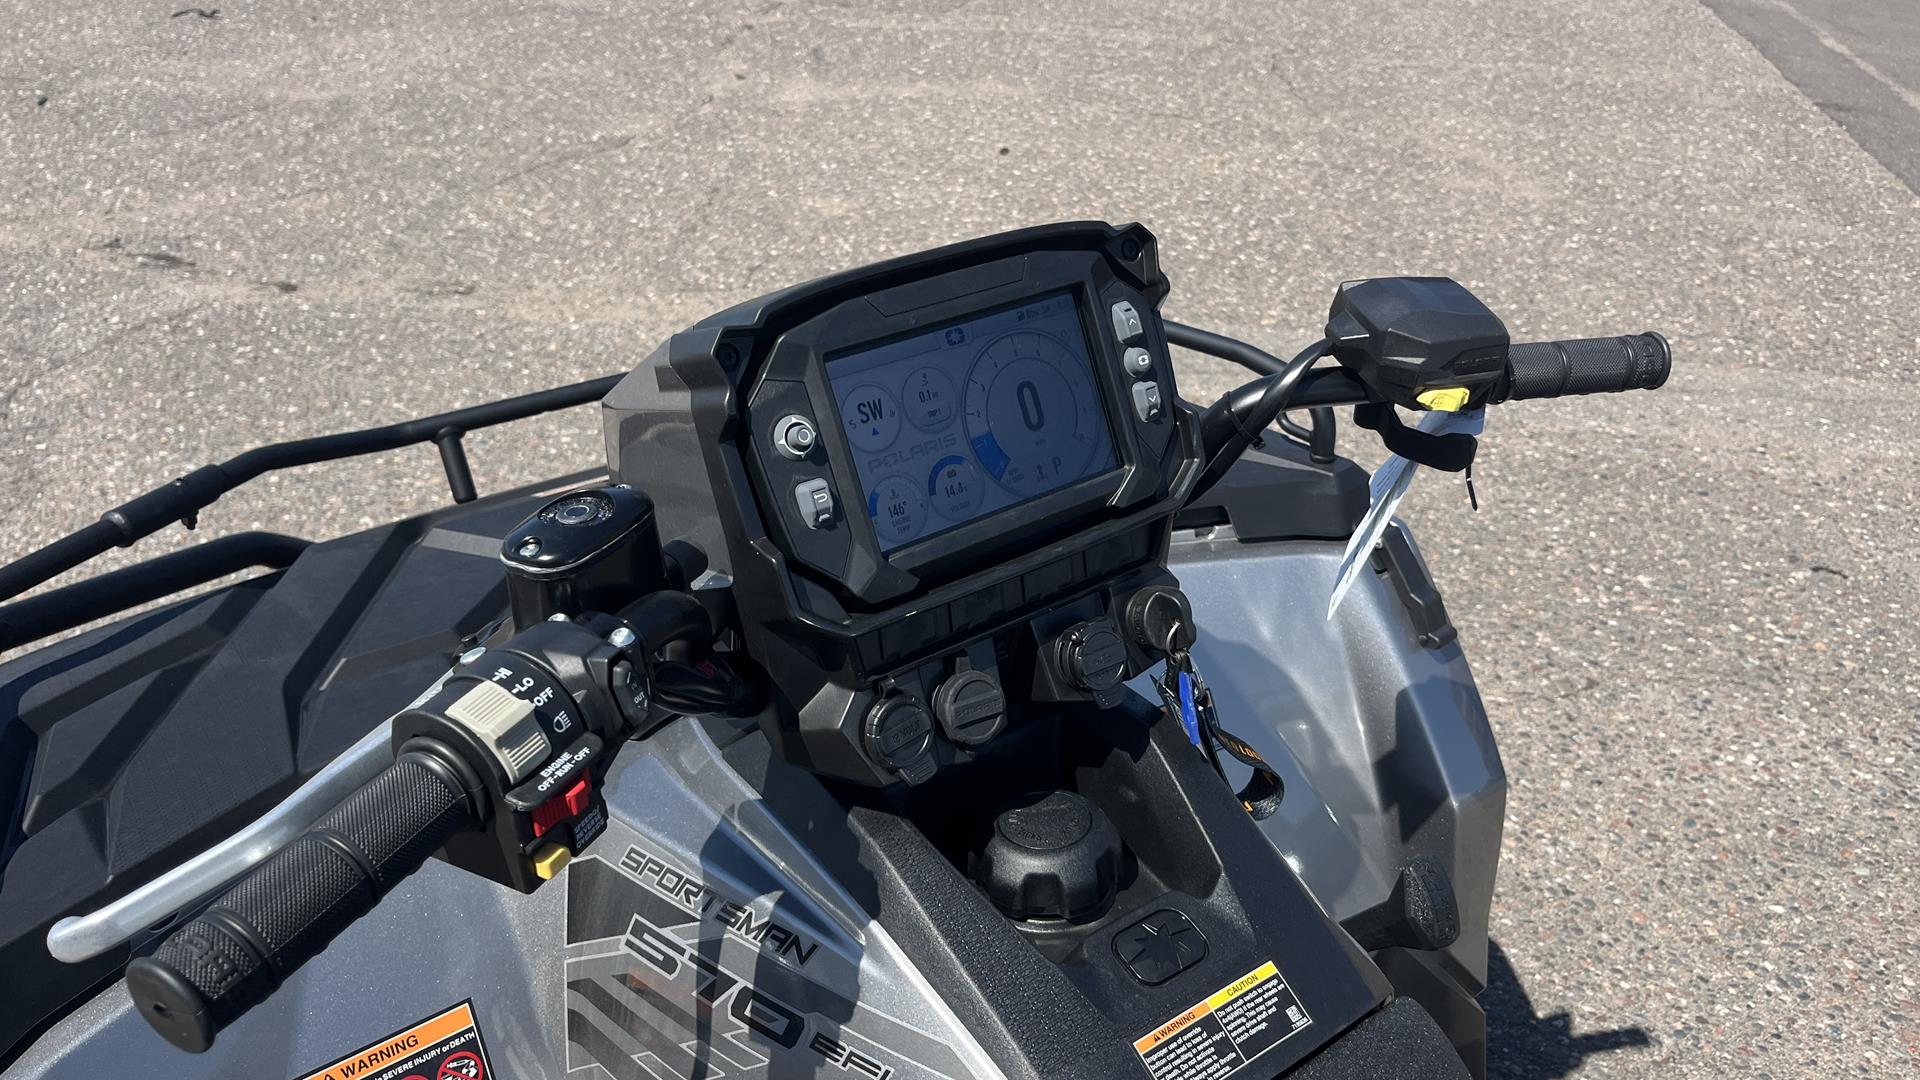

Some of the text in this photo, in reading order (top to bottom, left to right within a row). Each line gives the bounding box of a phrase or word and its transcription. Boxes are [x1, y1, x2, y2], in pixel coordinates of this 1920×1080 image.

[918, 390, 931, 403] 0.1
[1017, 380, 1044, 431] 0
[857, 398, 883, 424] SW
[849, 420, 856, 429] S
[868, 433, 957, 473] POLARIS
[1052, 456, 1061, 475] P
[633, 692, 645, 704] OUT
[540, 751, 573, 777] ENGINE
[620, 844, 818, 966] SPORTSMAN
[623, 913, 895, 1080] 570 EFI
[1225, 1005, 1233, 1013] not
[1232, 999, 1244, 1009] push
[1243, 991, 1258, 1001] switch
[1262, 979, 1278, 990] engage
[1226, 974, 1259, 997] CAUTION
[1254, 996, 1263, 1004] rear
[1263, 988, 1278, 999] wheels
[1245, 1010, 1256, 1018] This
[1255, 1004, 1266, 1012] may
[1265, 997, 1278, 1007] cause
[1159, 1012, 1196, 1038] WARNING
[1231, 1006, 1277, 1037] severe drive shaft and
[1146, 1047, 1168, 1063] Improper
[1168, 1042, 1177, 1050] use
[1183, 1027, 1201, 1041] override
[1235, 1033, 1250, 1044] clutch
[341, 1035, 419, 1079] WARNING
[382, 1031, 476, 1080] SEVERE INJURY or DEATH
[1150, 1058, 1167, 1070] button
[1167, 1052, 1176, 1060] can
[1175, 1044, 1187, 1054] lead
[1191, 1036, 1202, 1044] loss
[1155, 1063, 1172, 1077] control
[1172, 1051, 1193, 1066] resulting
[1197, 1039, 1213, 1051] severe
[1211, 1031, 1225, 1041] injury
[1188, 1058, 1197, 1066] not
[1196, 1047, 1215, 1061] activate
[1207, 1063, 1220, 1073] apply
[1219, 1052, 1236, 1065] throttle
[1183, 1068, 1196, 1078] while
[1195, 1058, 1213, 1070] throttle
[1213, 1066, 1232, 1079] reverse.
